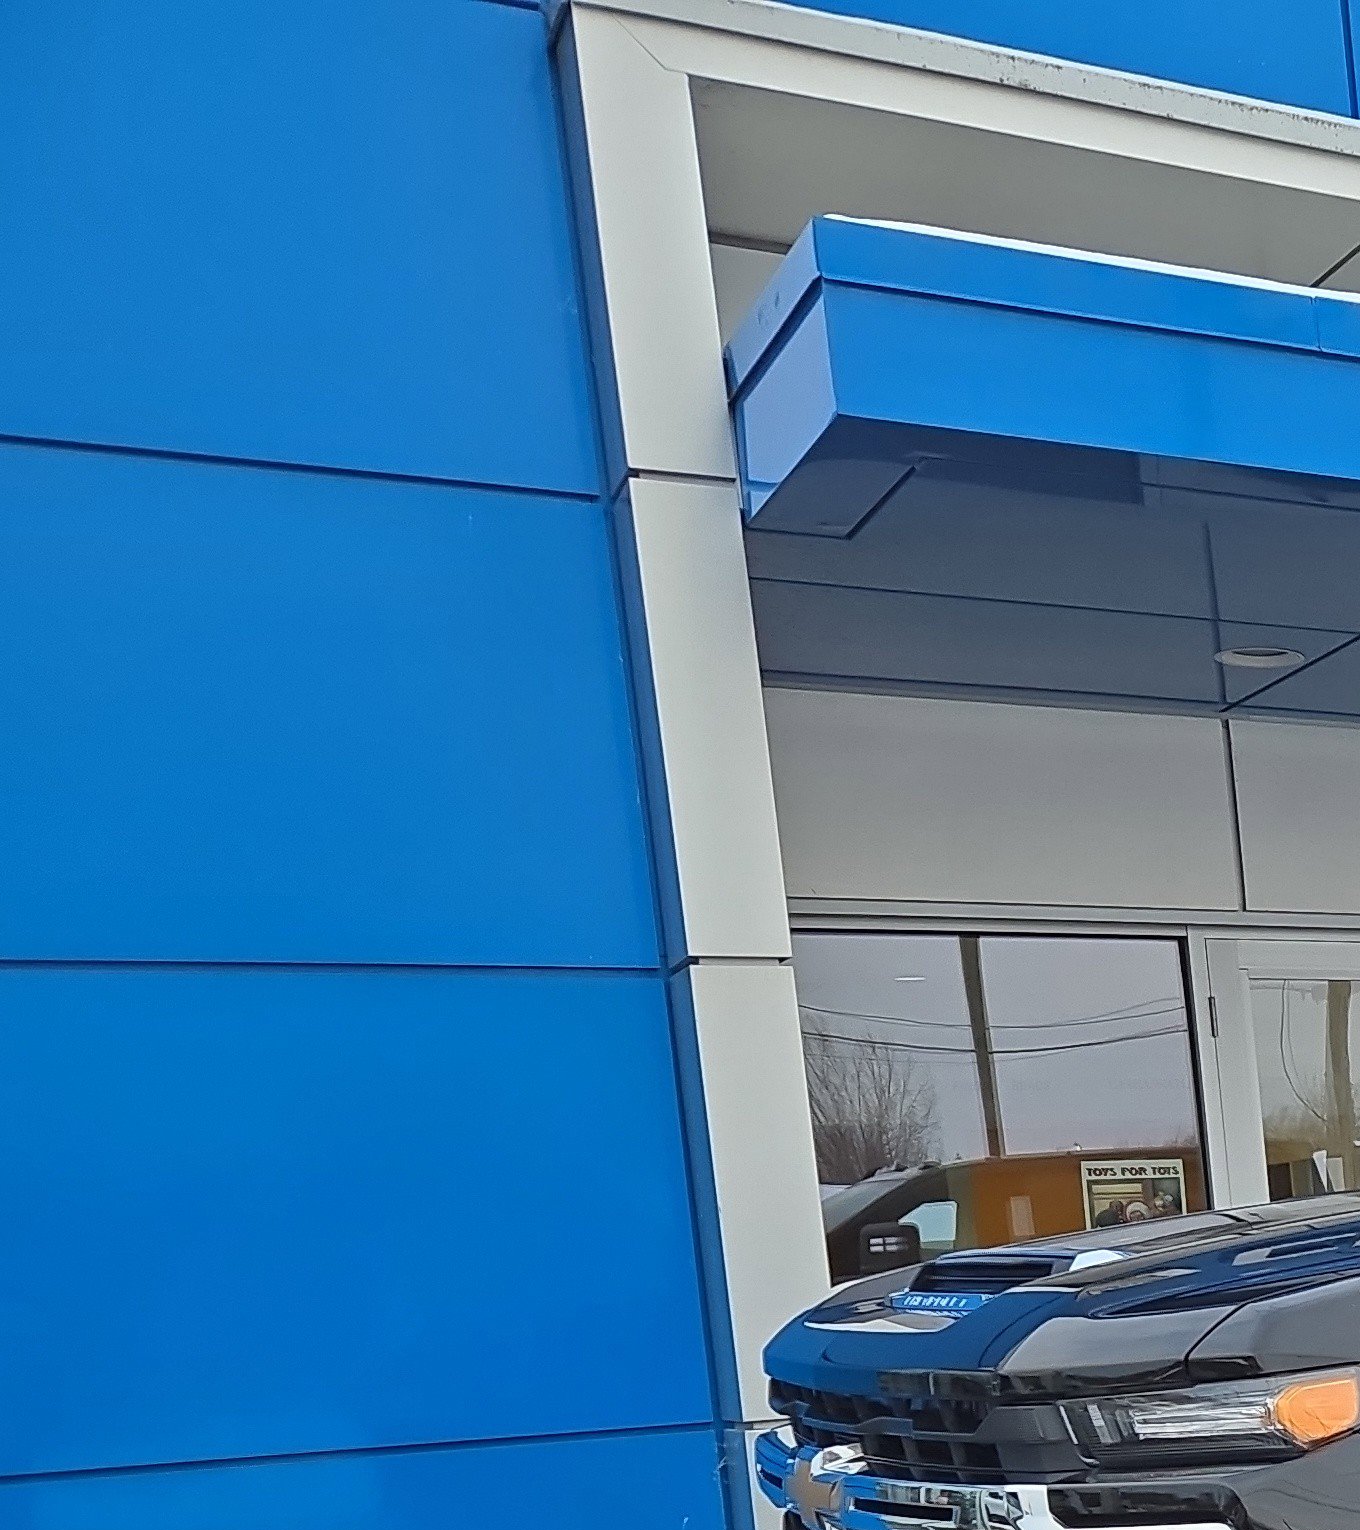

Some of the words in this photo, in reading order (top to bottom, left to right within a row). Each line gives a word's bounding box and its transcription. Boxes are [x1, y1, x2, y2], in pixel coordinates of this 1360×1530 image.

[1086, 1166, 1117, 1177] TOYS
[1121, 1166, 1148, 1176] FOR
[1151, 1165, 1180, 1176] TOTS
